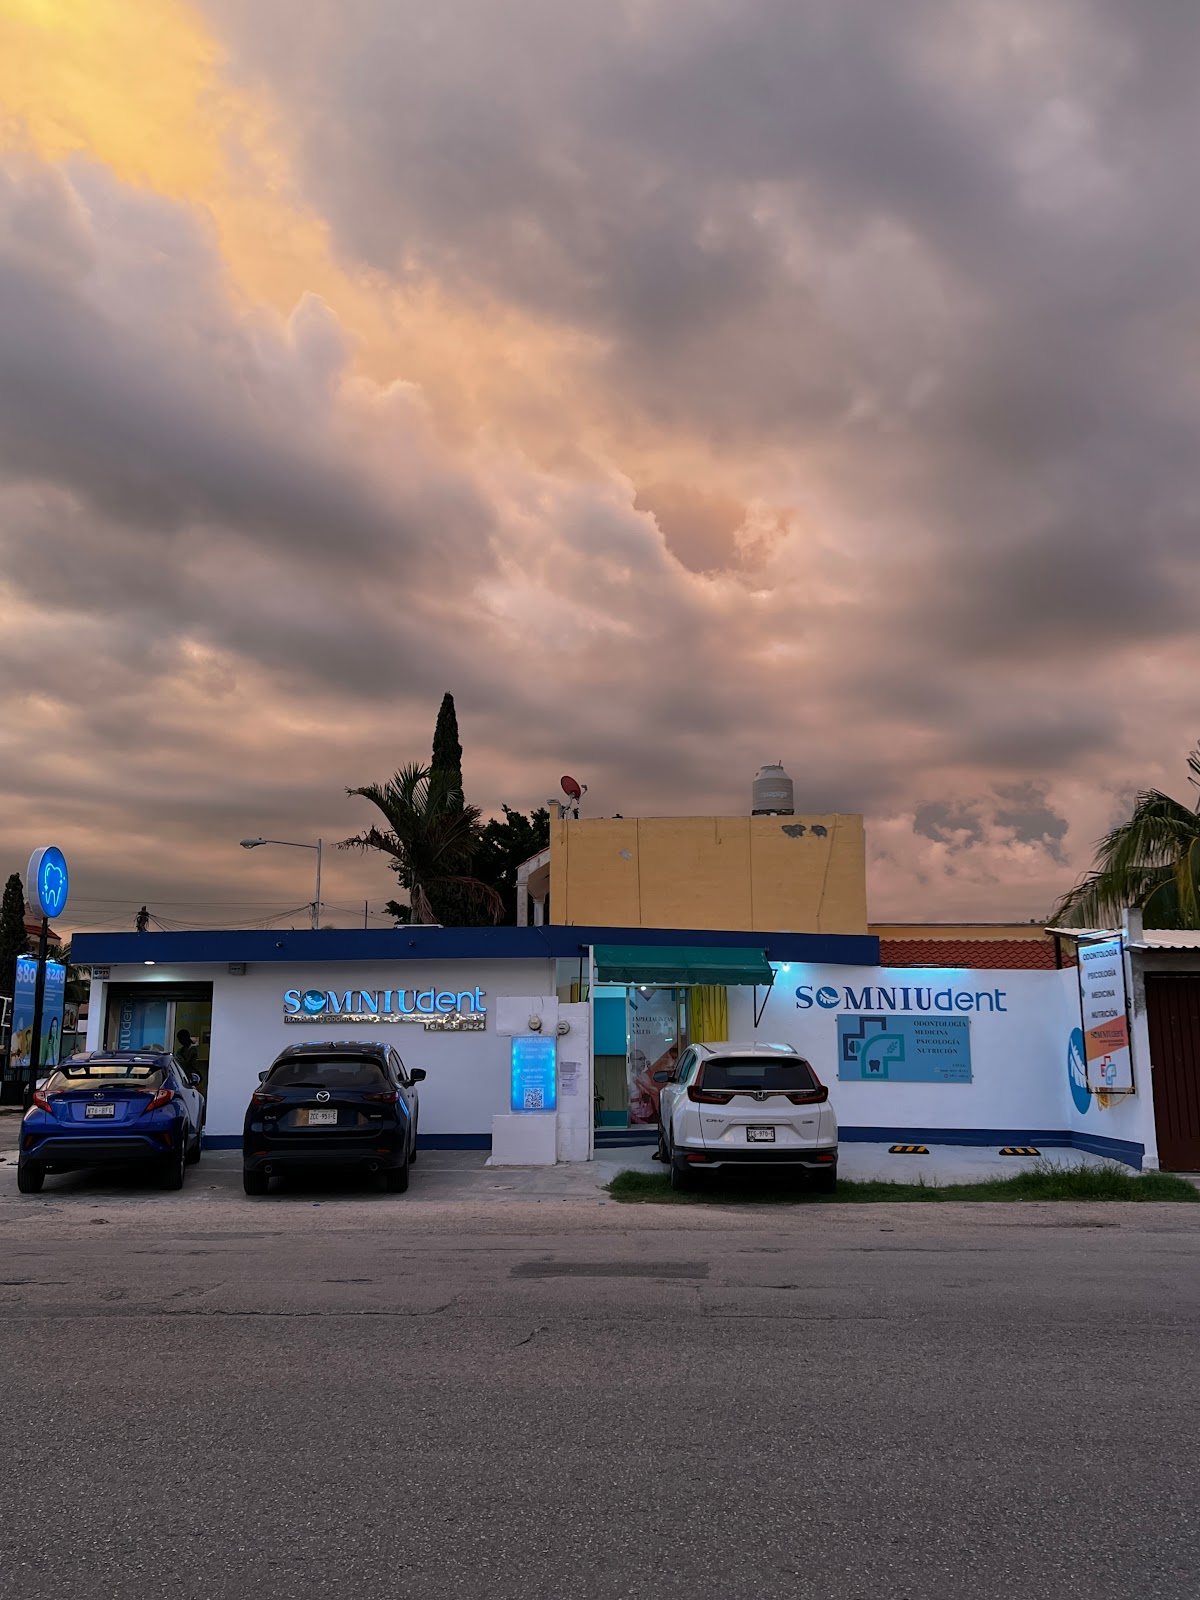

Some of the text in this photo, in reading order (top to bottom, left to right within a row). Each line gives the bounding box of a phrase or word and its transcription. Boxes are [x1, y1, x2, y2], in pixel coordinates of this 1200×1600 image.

[17, 963, 36, 983] $80
[46, 967, 65, 984] $249
[1087, 968, 1117, 980] PSICOLOGÍA
[1091, 989, 1116, 999] MEDICINA
[1091, 1008, 1118, 1019] NUTRICIÓN
[913, 1020, 967, 1028] ODONTOLOGÍA
